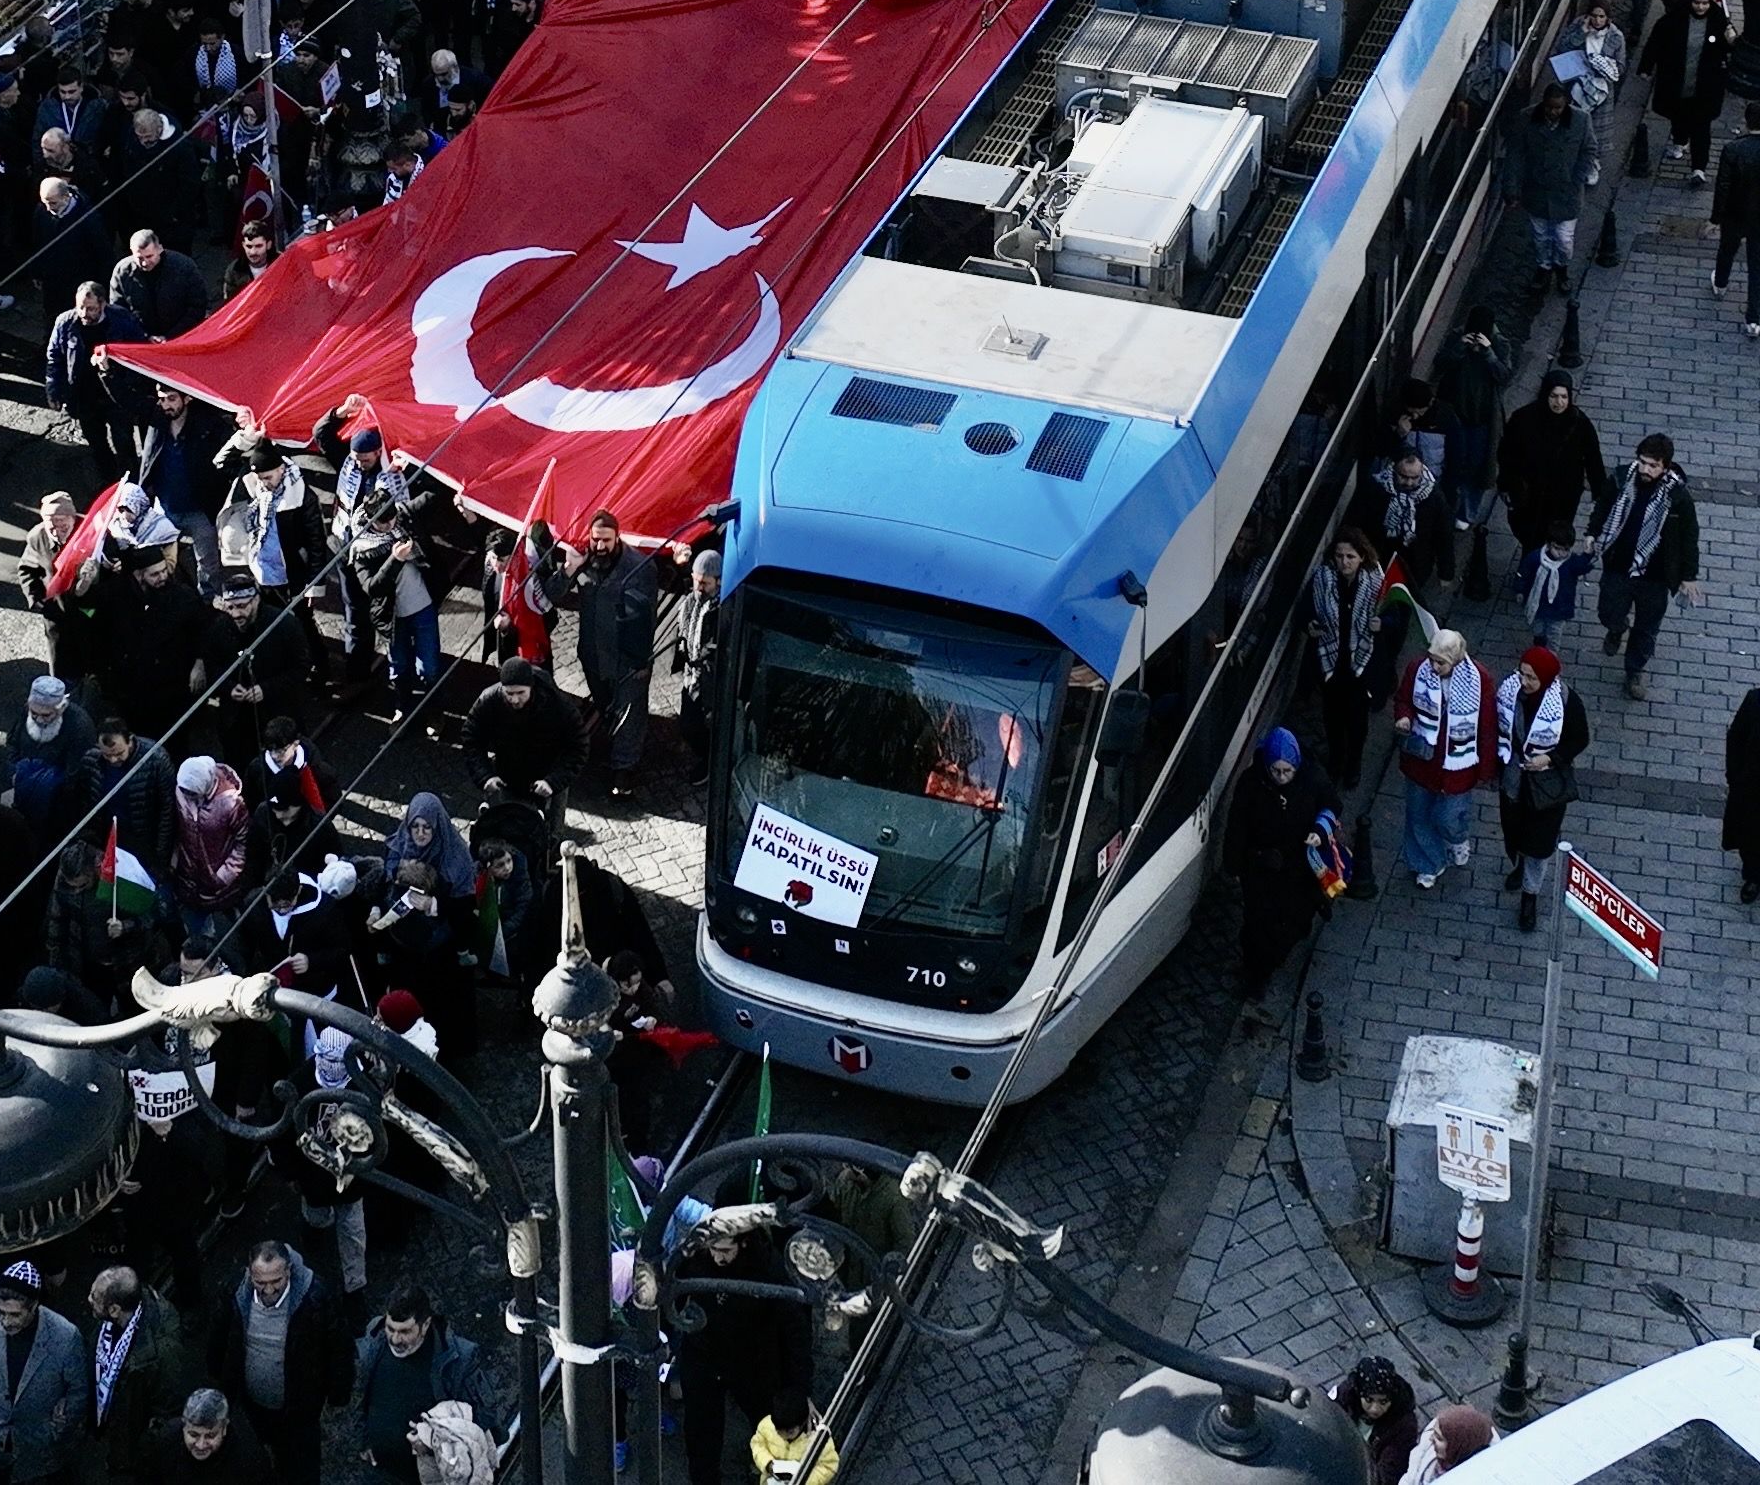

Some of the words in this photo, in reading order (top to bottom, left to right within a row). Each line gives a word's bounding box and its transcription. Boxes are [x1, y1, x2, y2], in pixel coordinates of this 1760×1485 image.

[751, 833, 865, 896] KAPATILSIN!
[757, 814, 823, 858] İNCİRLİK
[826, 847, 869, 877] ÜSSÜ
[906, 965, 946, 988] 710
[1442, 1148, 1506, 1179] WC
